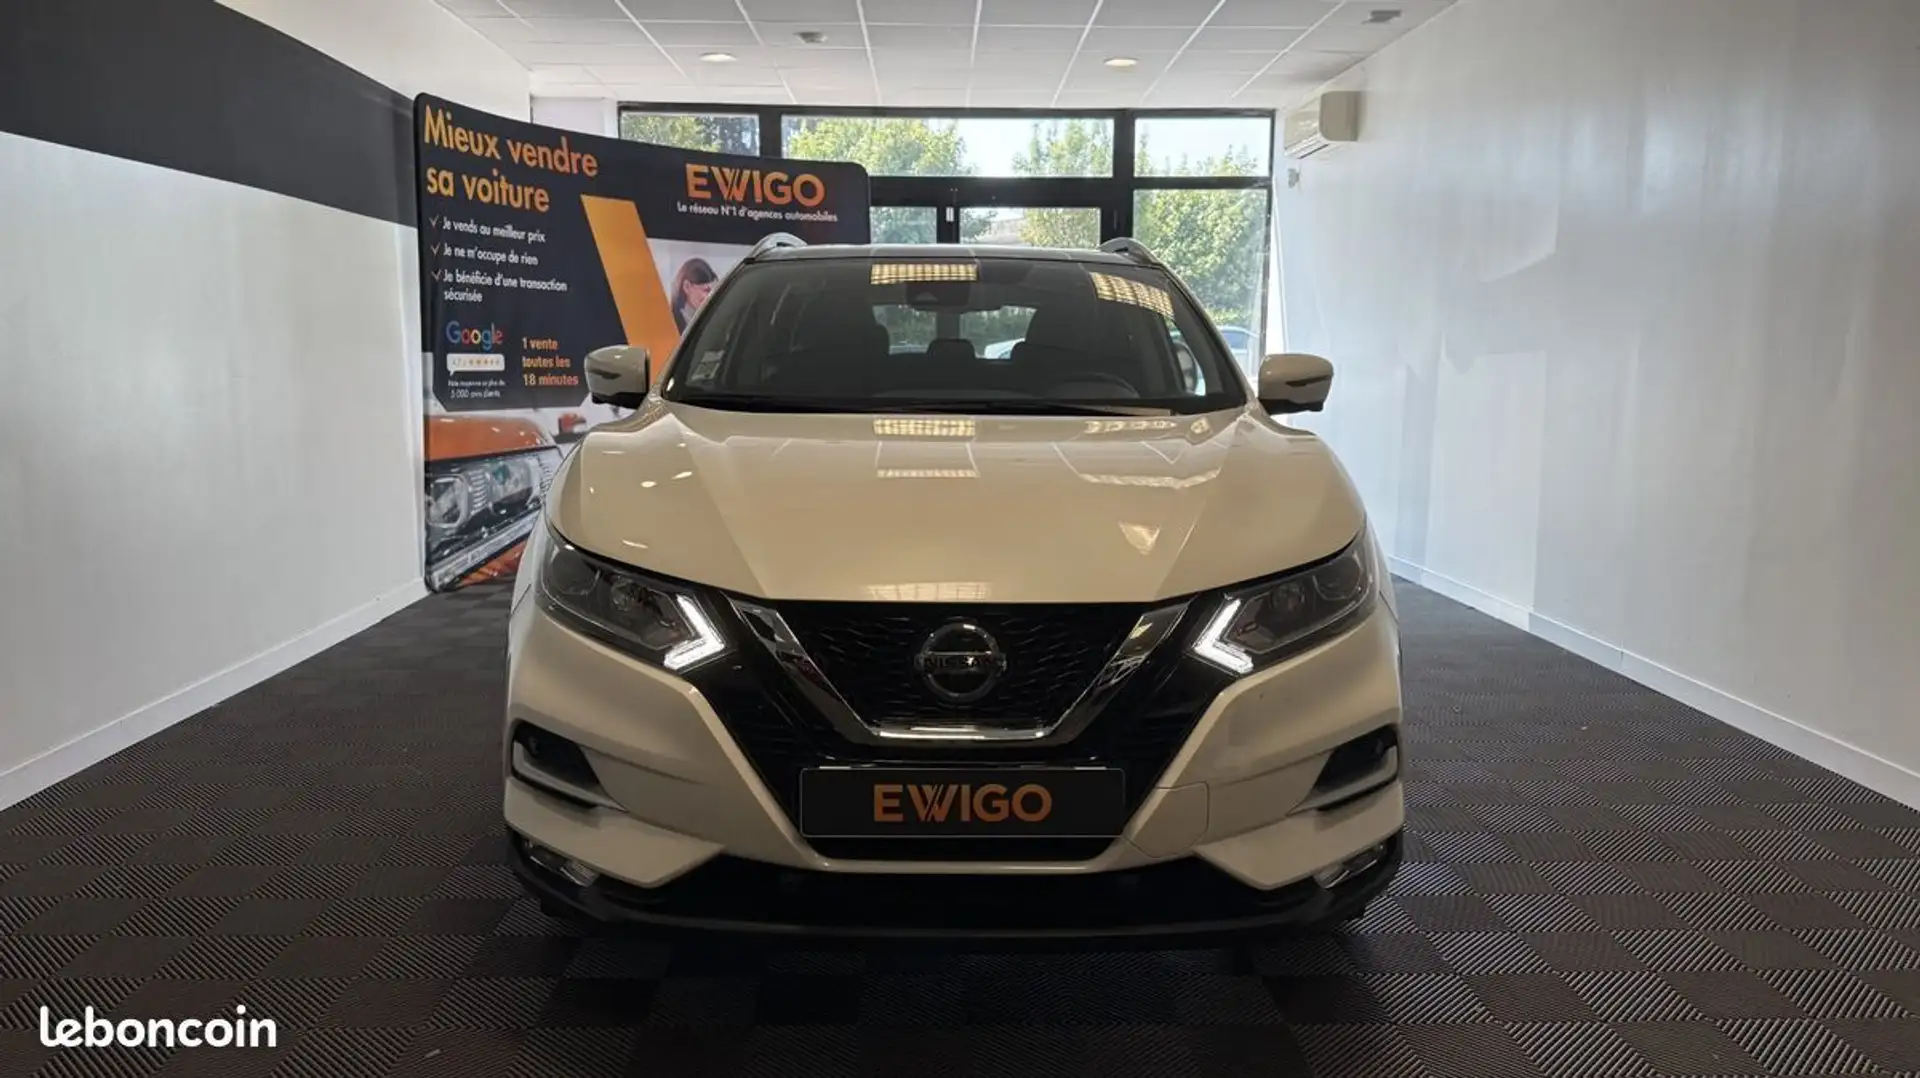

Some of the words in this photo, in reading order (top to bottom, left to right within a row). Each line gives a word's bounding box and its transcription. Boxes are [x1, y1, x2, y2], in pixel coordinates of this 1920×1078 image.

[424, 104, 501, 160] Mieux
[506, 136, 598, 177] vendre
[427, 167, 454, 197] sa
[462, 168, 549, 212] voiture
[685, 163, 826, 207] EWIGO
[677, 201, 688, 212] Le
[689, 202, 719, 215] réseau
[738, 206, 783, 221] d'agences
[785, 210, 838, 222] automobiles
[443, 216, 451, 230] Je
[453, 218, 478, 234] vends
[480, 225, 490, 235] au
[493, 224, 525, 239] meilleur
[528, 229, 546, 244] prix
[443, 242, 452, 256] Je
[454, 247, 465, 257] ne
[467, 246, 506, 265] m'occupe
[508, 249, 519, 264] de
[521, 252, 538, 265] rien
[443, 269, 453, 282] Je
[456, 269, 492, 286] bénéficie
[494, 272, 518, 287] d'une
[520, 277, 568, 292] transaction
[444, 287, 483, 302] sécurisée
[446, 320, 503, 351] Google
[522, 337, 528, 349] 1
[530, 338, 559, 350] vente
[522, 355, 554, 368] toutes
[556, 355, 571, 368] les
[523, 373, 536, 386] 18
[538, 373, 579, 386] minutes
[873, 784, 1052, 822] EWIGO
